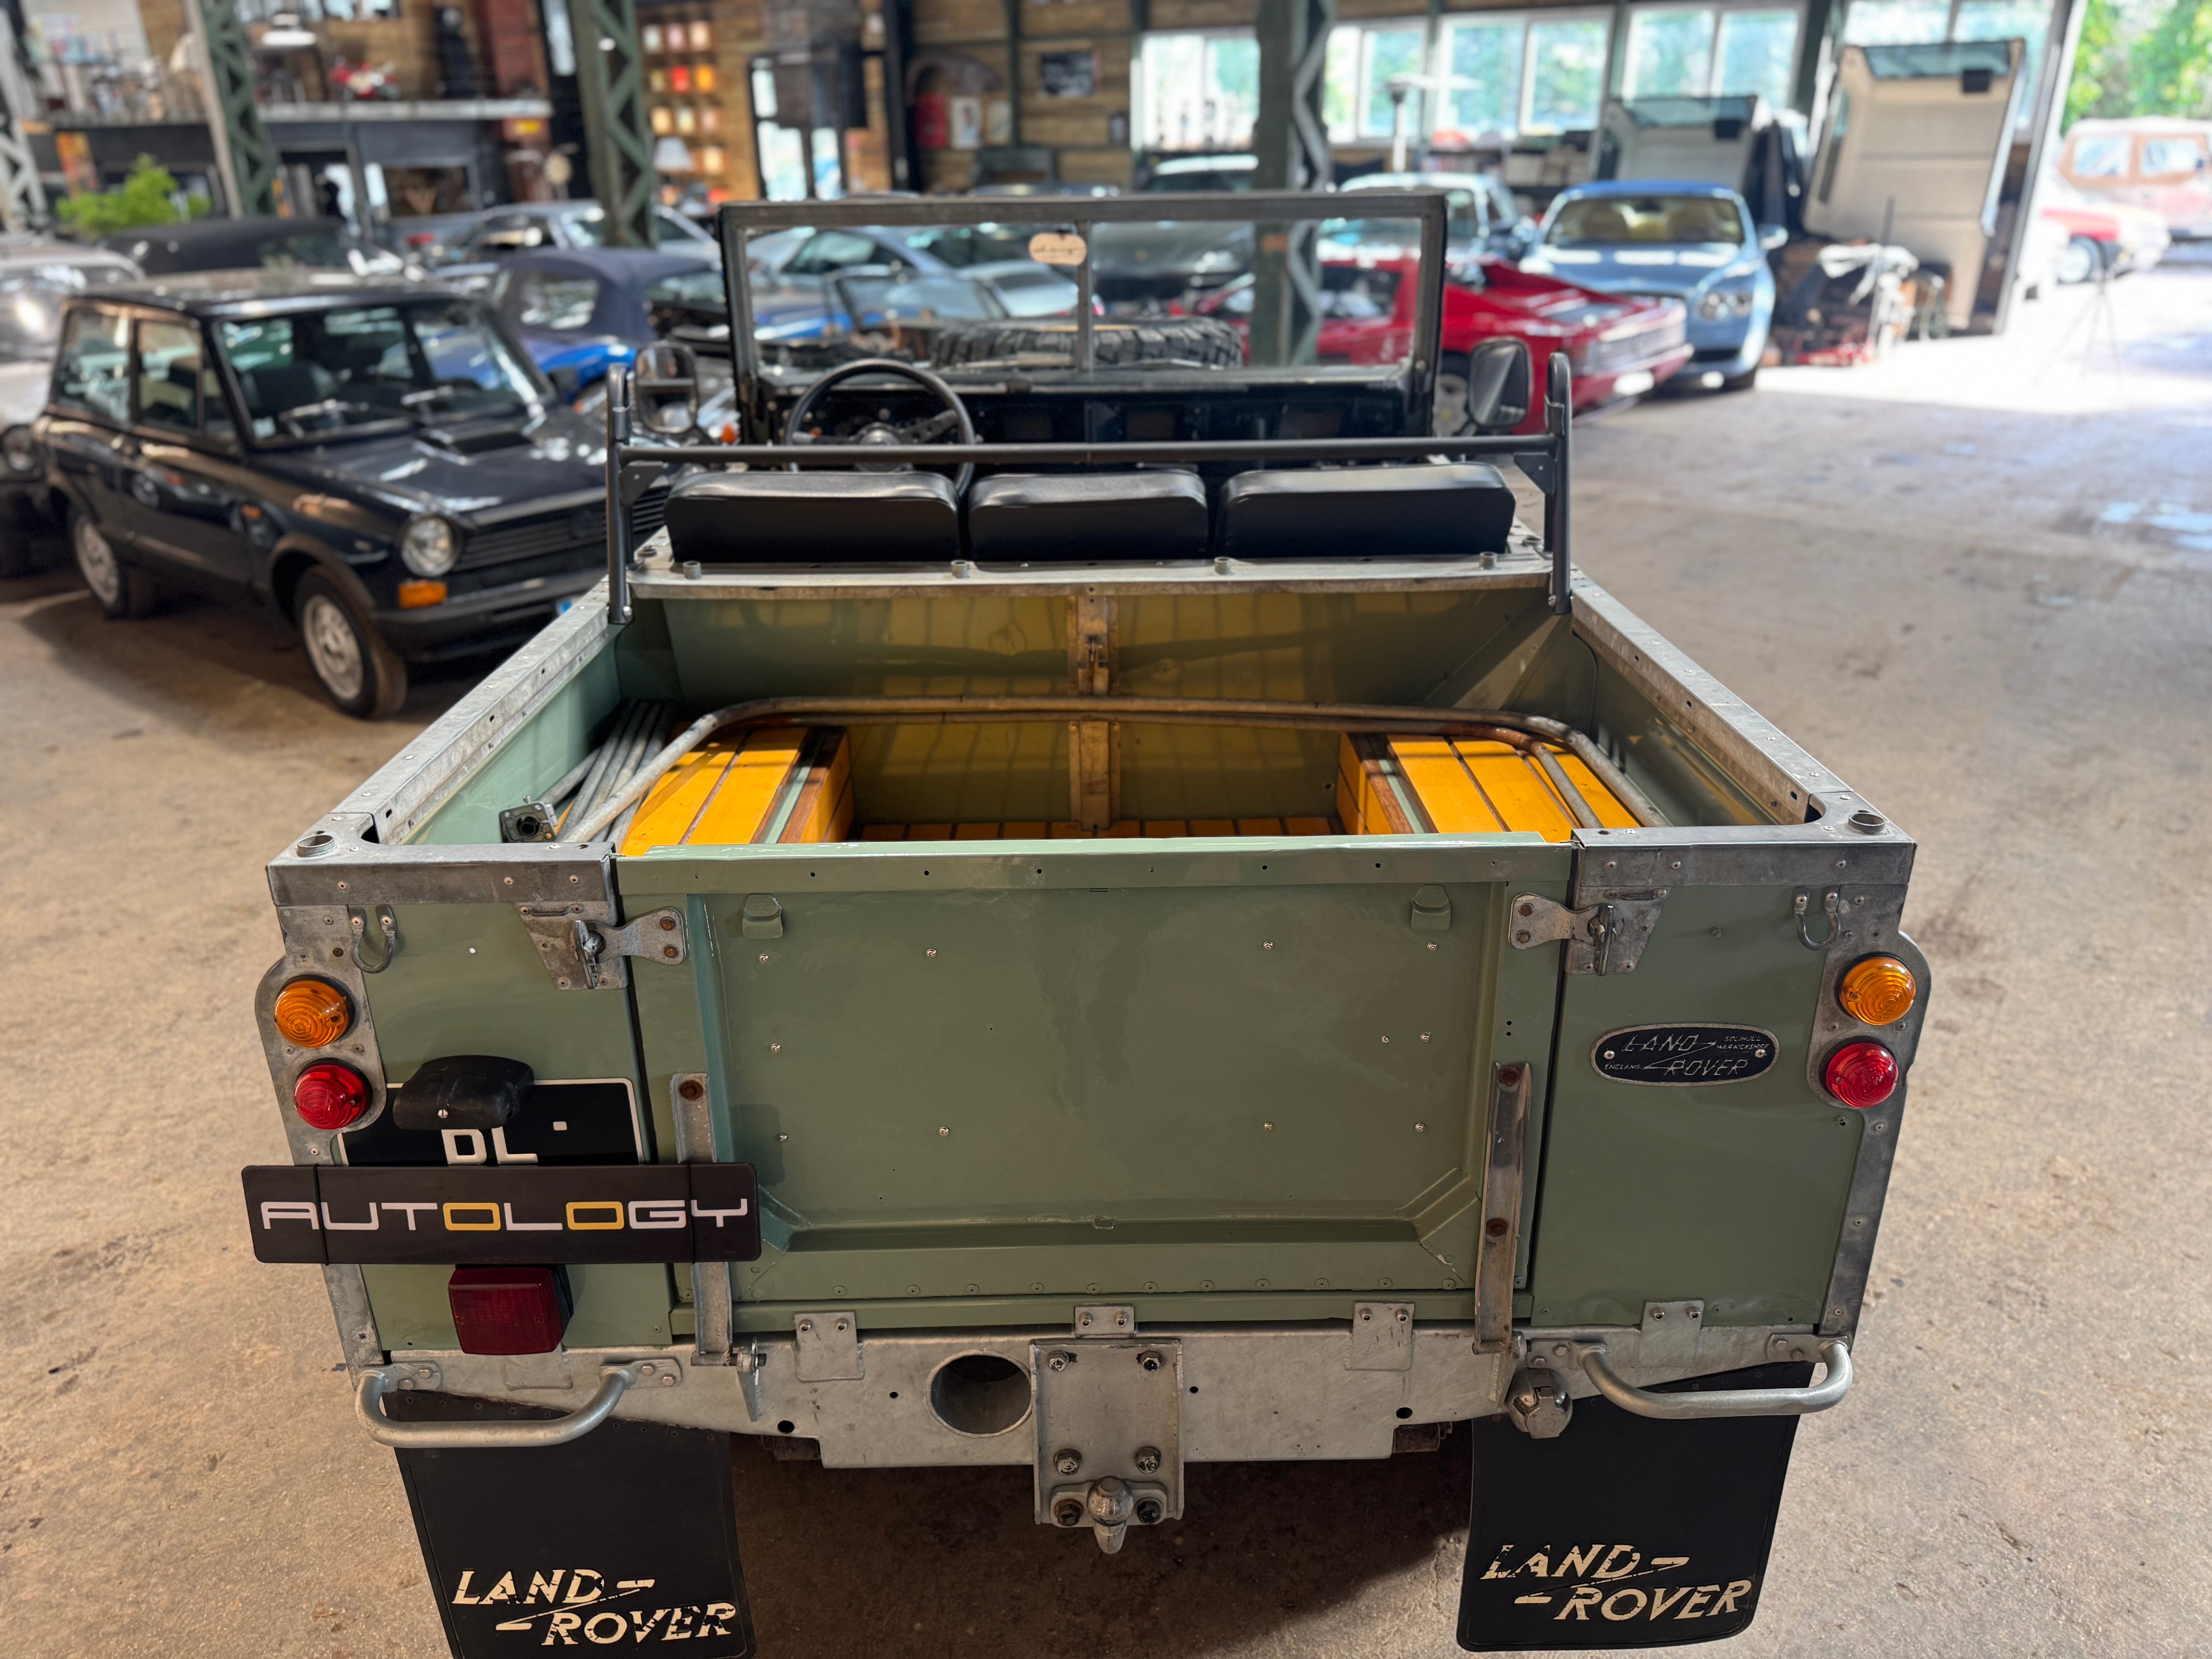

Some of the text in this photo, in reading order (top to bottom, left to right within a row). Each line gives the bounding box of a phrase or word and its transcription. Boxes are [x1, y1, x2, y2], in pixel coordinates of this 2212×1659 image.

[1621, 1034, 1699, 1051] LAND
[1664, 1059, 1748, 1076] ROVER
[260, 1198, 748, 1231] AUTOLOGY
[1480, 1544, 1641, 1580] LAND
[452, 1568, 605, 1605] LAND
[1553, 1579, 1752, 1621] ROVER
[541, 1602, 737, 1646] ROVER
